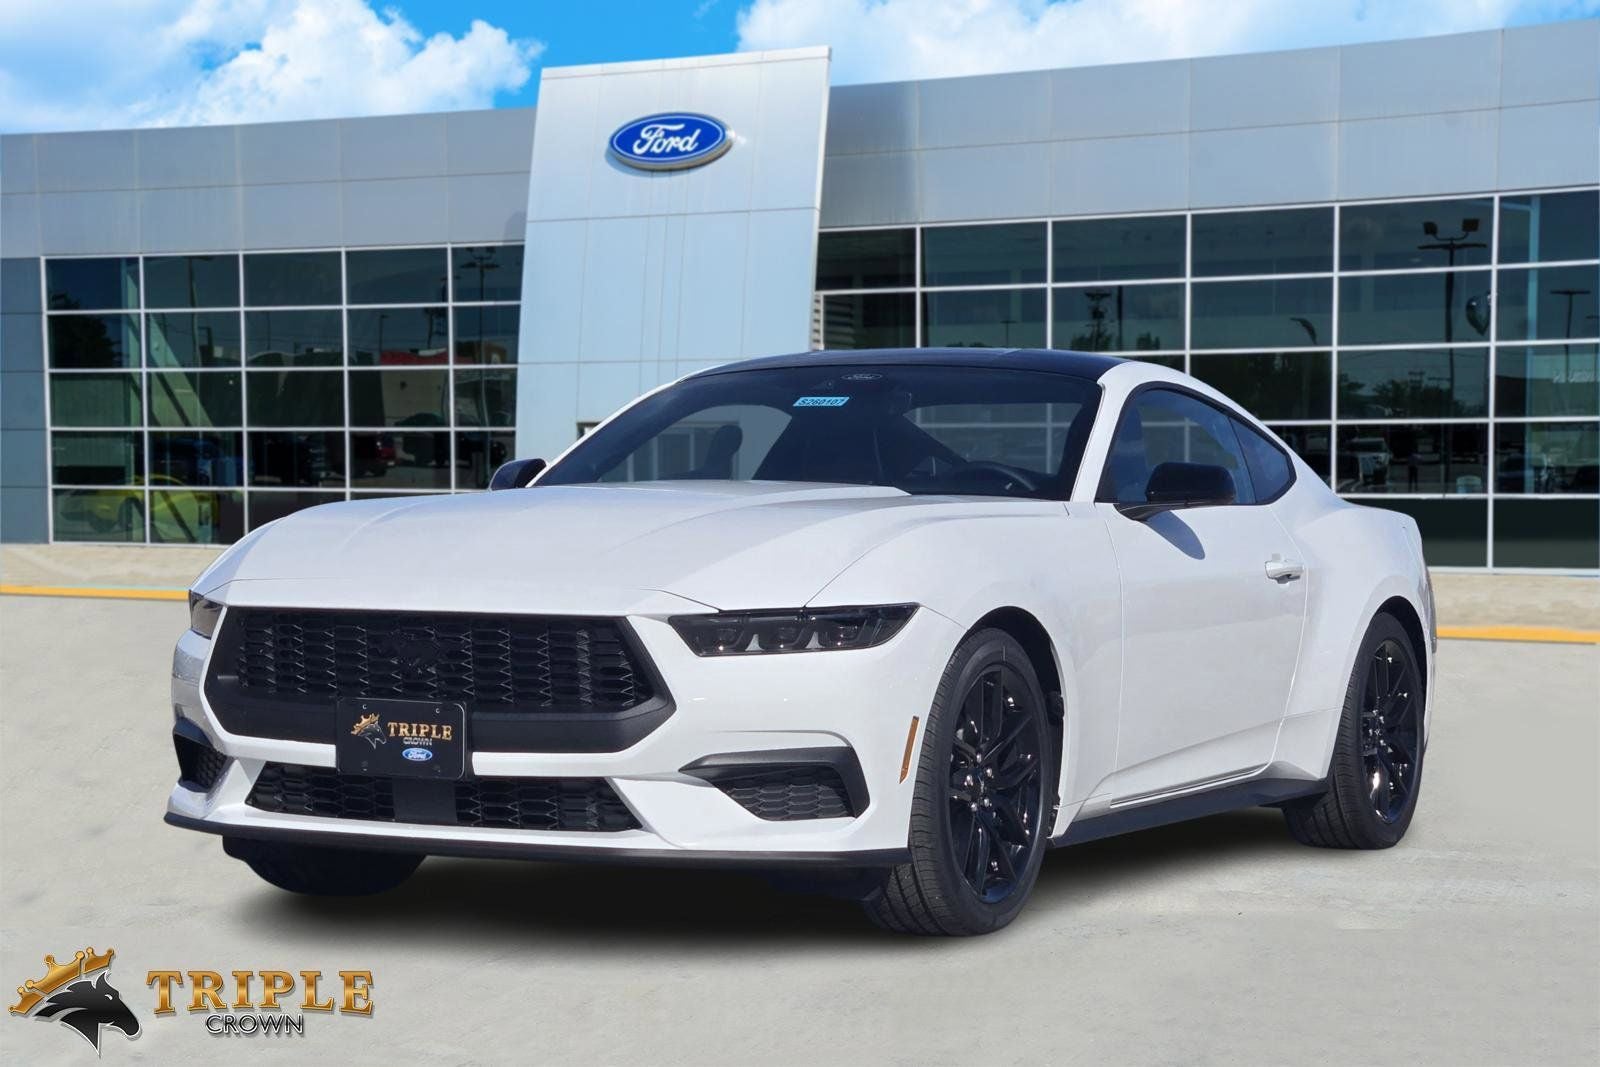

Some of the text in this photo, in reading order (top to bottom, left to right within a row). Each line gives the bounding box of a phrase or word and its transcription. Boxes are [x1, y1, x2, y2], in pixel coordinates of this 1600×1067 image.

[632, 124, 701, 155] Ford
[387, 722, 452, 740] TRIPLE
[403, 736, 432, 746] CROWN
[407, 750, 427, 760] Ford
